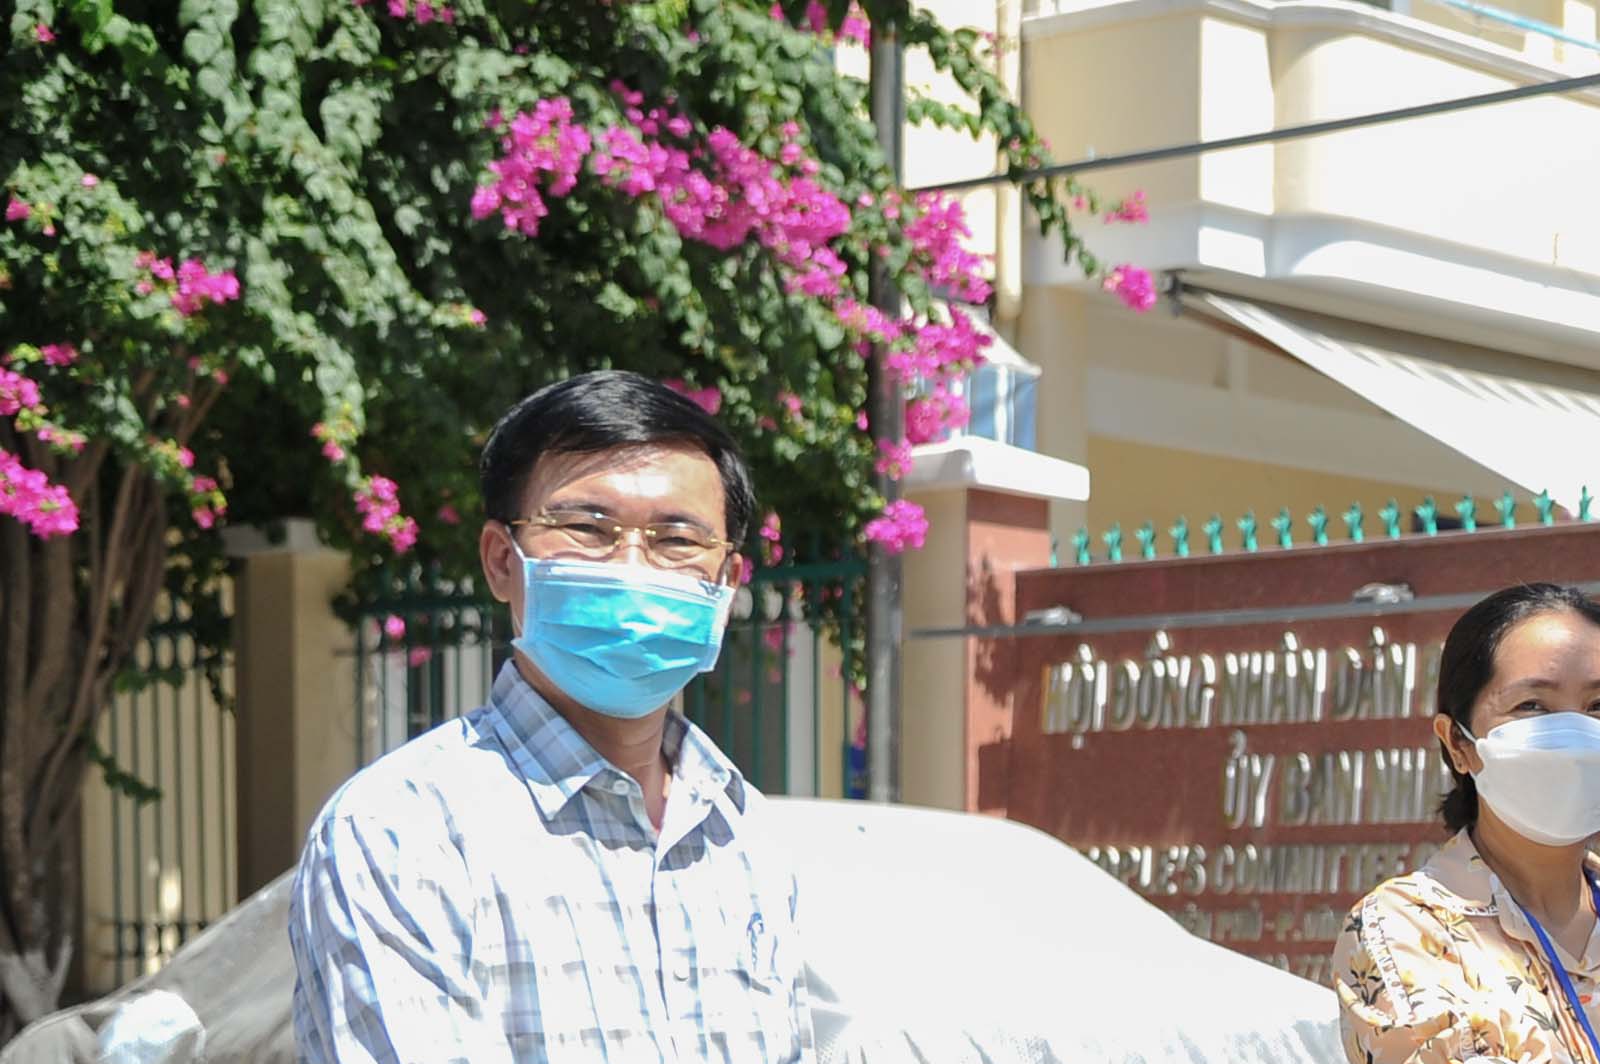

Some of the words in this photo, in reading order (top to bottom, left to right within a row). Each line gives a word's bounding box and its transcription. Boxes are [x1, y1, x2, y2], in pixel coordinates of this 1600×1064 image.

[1042, 643, 1109, 750] HỘI
[1219, 631, 1328, 726] NHÂN
[1331, 626, 1416, 722] DÂN
[1222, 730, 1276, 830] ỦY
[1281, 751, 1364, 827] BAN
